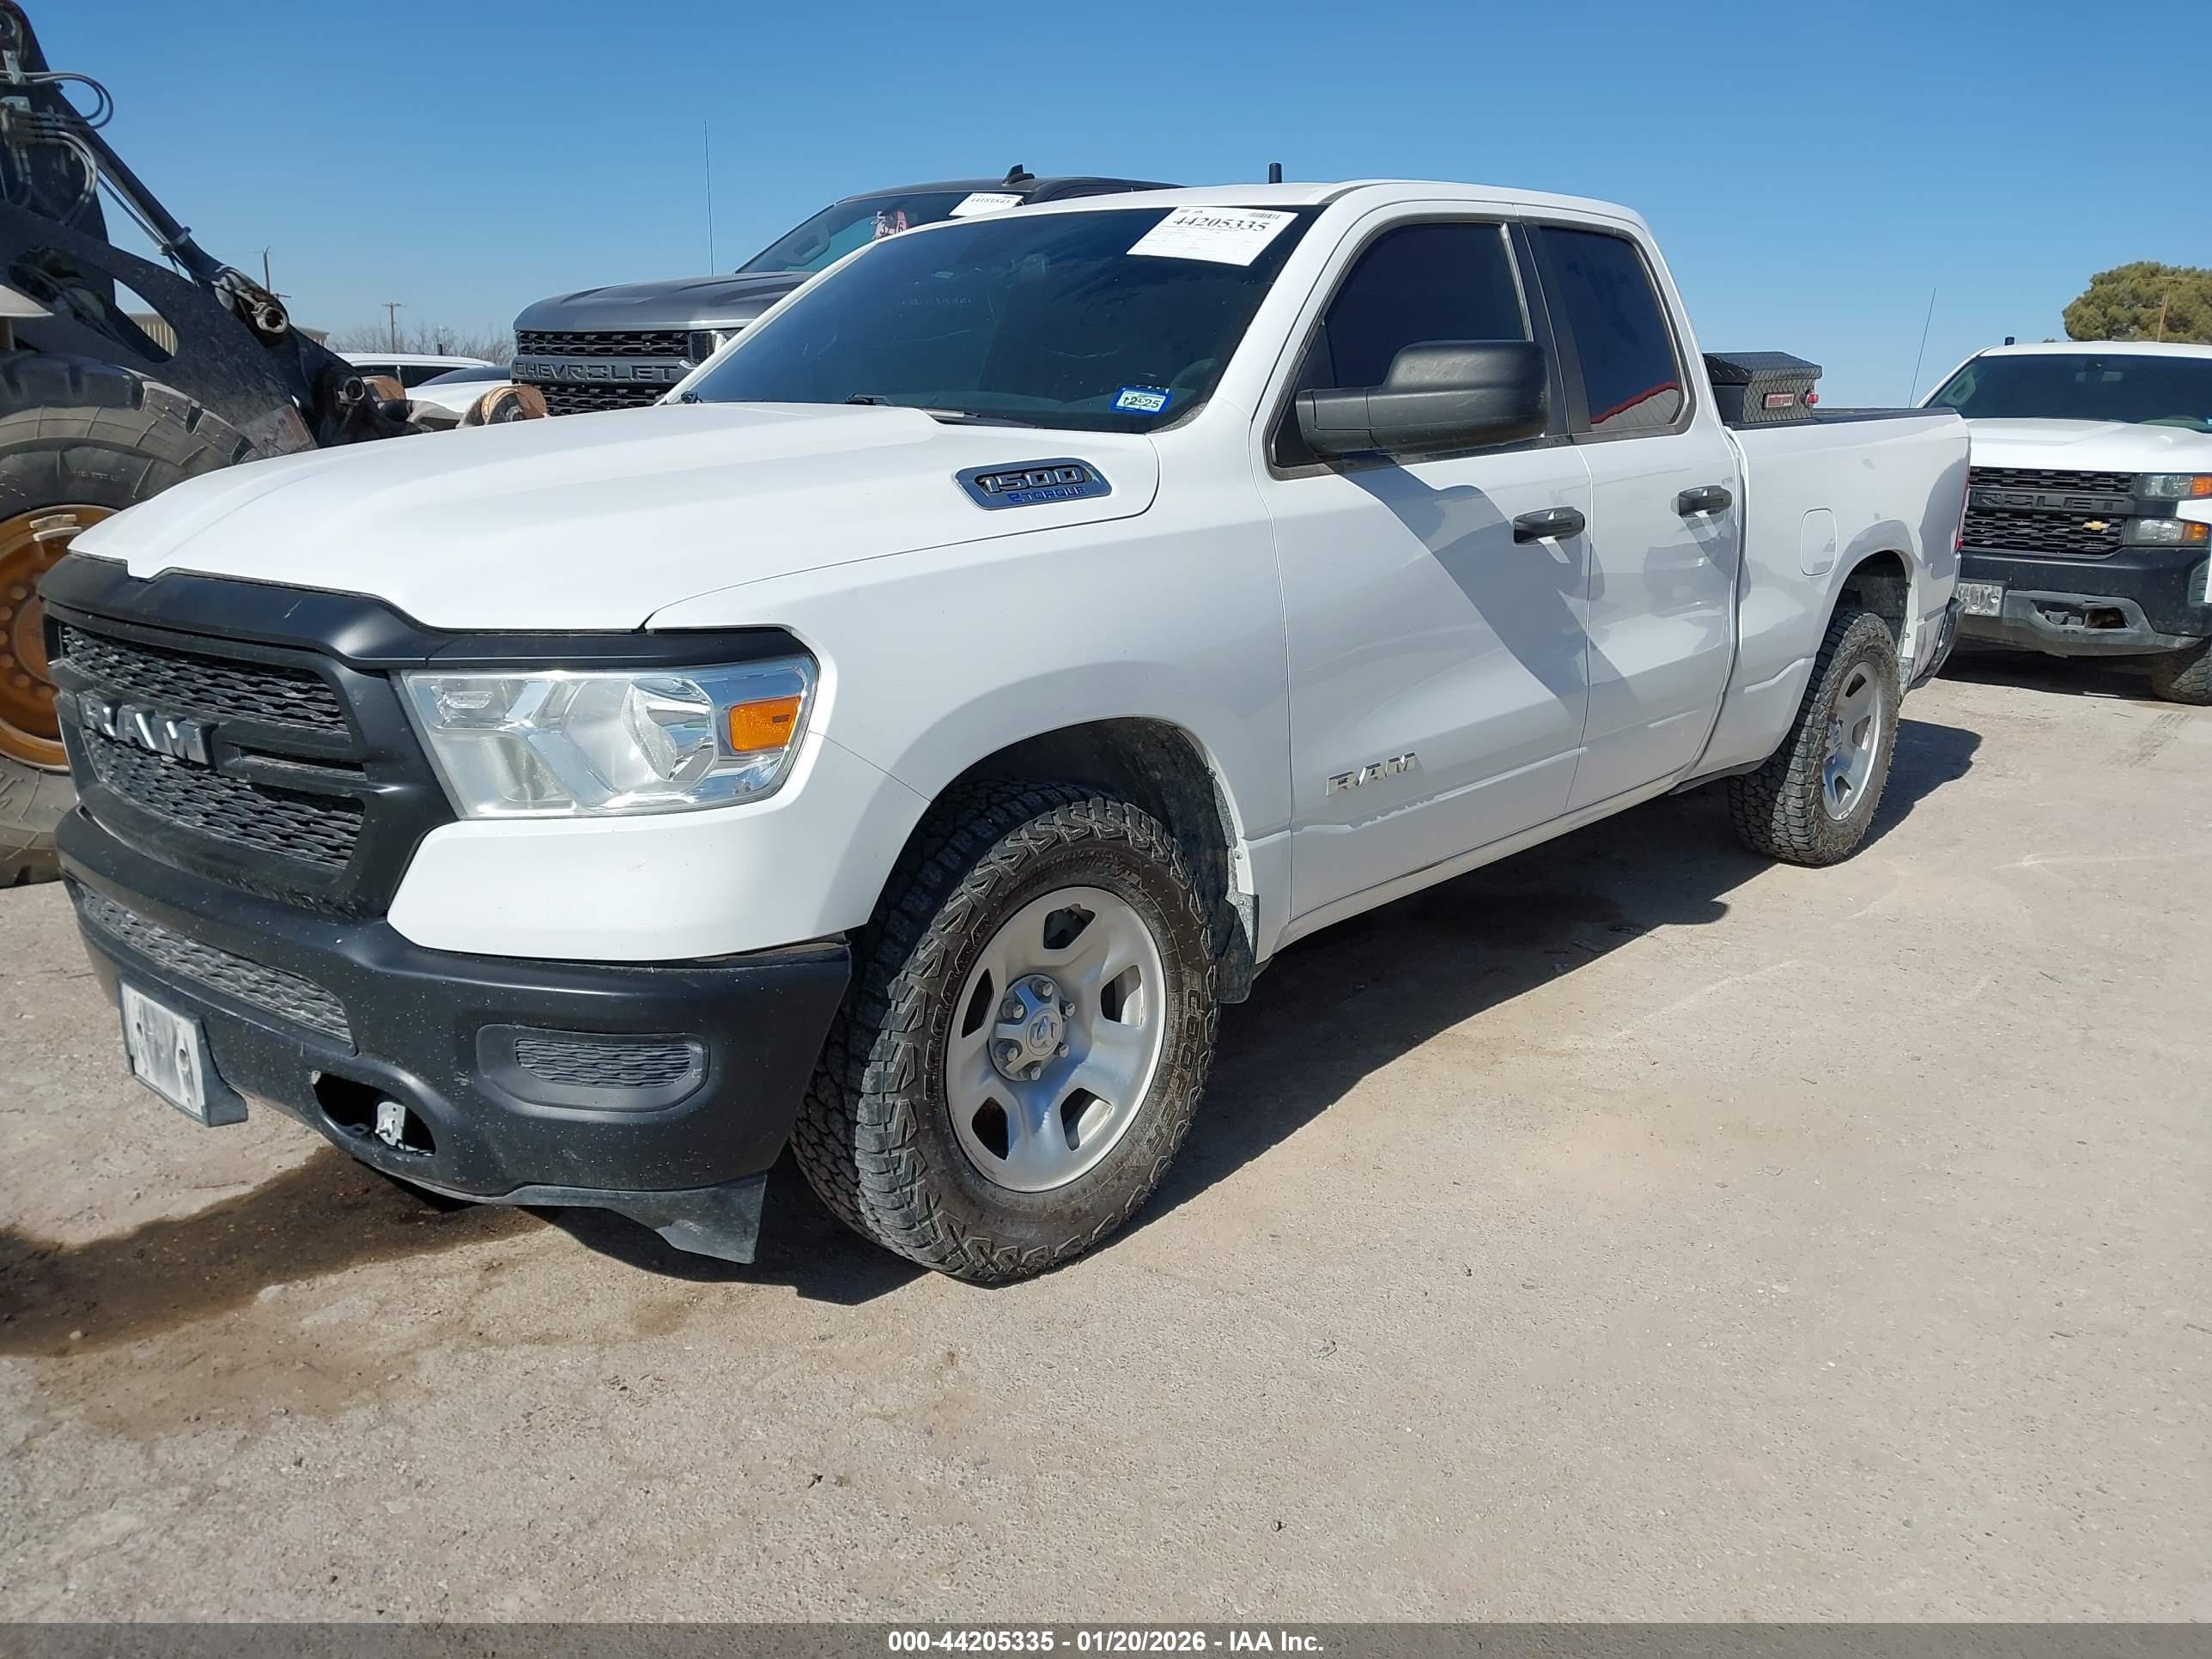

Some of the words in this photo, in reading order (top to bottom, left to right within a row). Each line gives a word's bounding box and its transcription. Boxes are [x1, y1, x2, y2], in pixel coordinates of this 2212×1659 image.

[1173, 216, 1270, 232] 44205335
[515, 362, 678, 382] CHEVROLET
[1143, 398, 1160, 409] 25
[980, 467, 1086, 495] 1500
[1326, 751, 1416, 797] RAM
